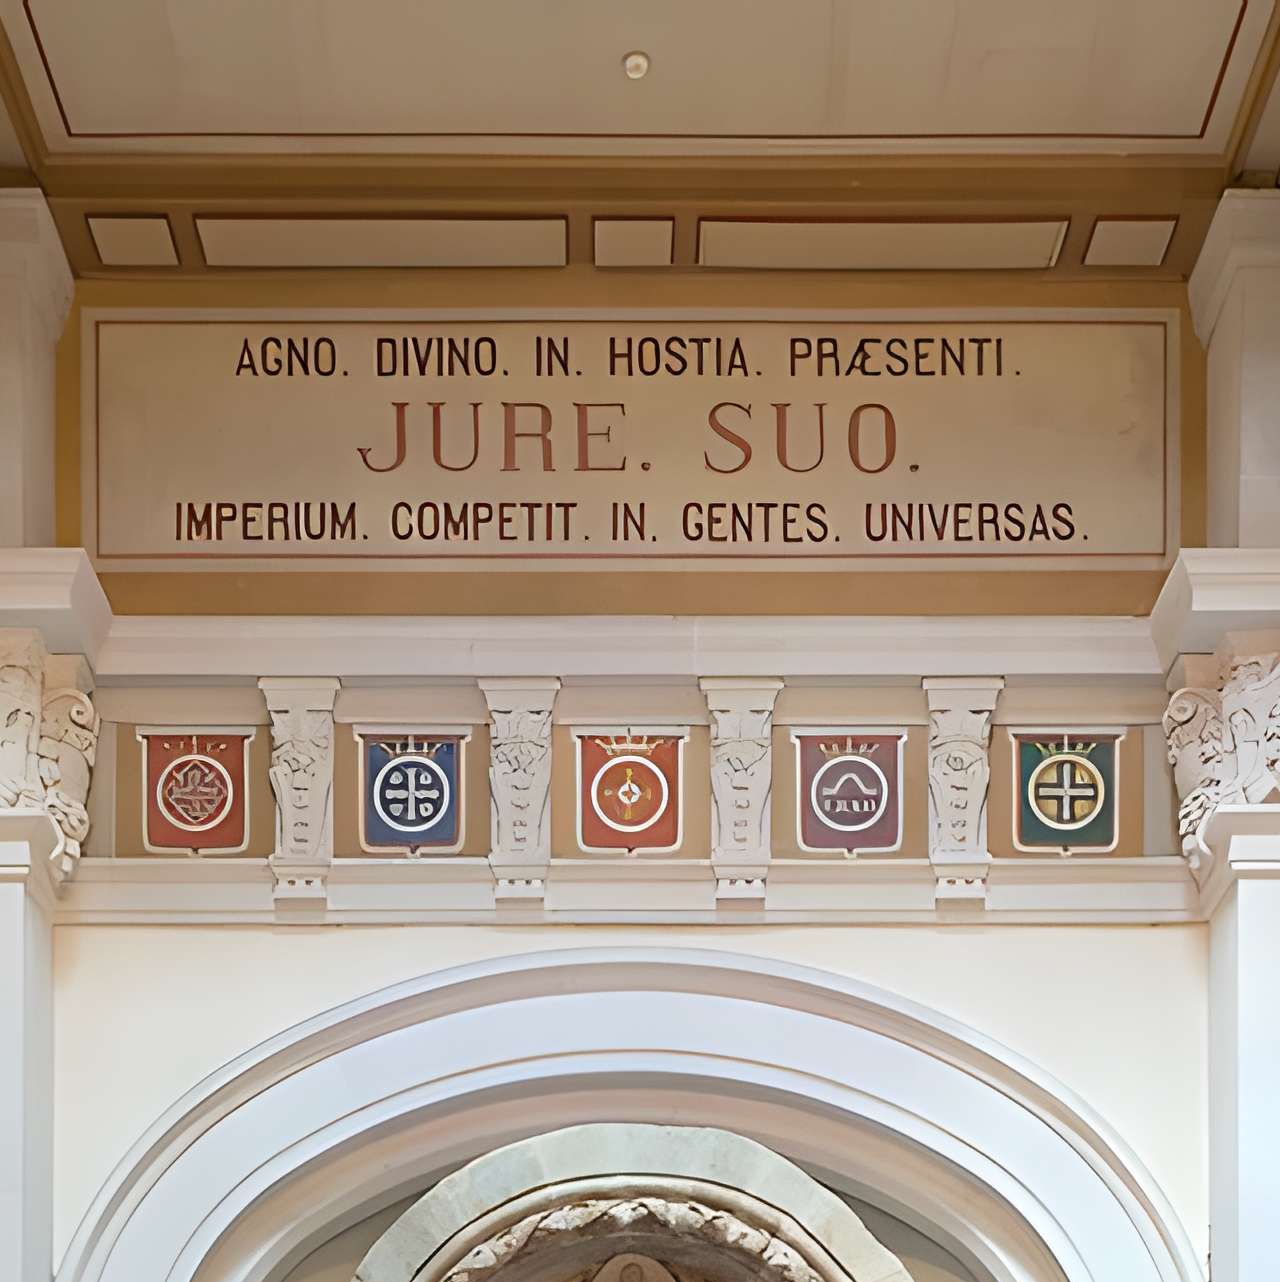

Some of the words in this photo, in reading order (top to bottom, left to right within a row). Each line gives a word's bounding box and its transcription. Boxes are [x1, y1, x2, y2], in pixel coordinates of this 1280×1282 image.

[235, 335, 349, 377] AGNO.
[376, 335, 510, 377] DIVINO.
[535, 335, 583, 377] IN.
[609, 335, 763, 377] HOSTIA.
[789, 336, 1021, 377] PRÆSENTI.
[356, 401, 652, 473] JURE.
[703, 400, 920, 475] SUO.
[175, 501, 369, 541] IMPERIUM.
[391, 501, 590, 541] COMPETIT.
[611, 501, 657, 542] IN.
[682, 501, 841, 542] GENTES.
[865, 501, 1089, 542] UNIVERSAS.
